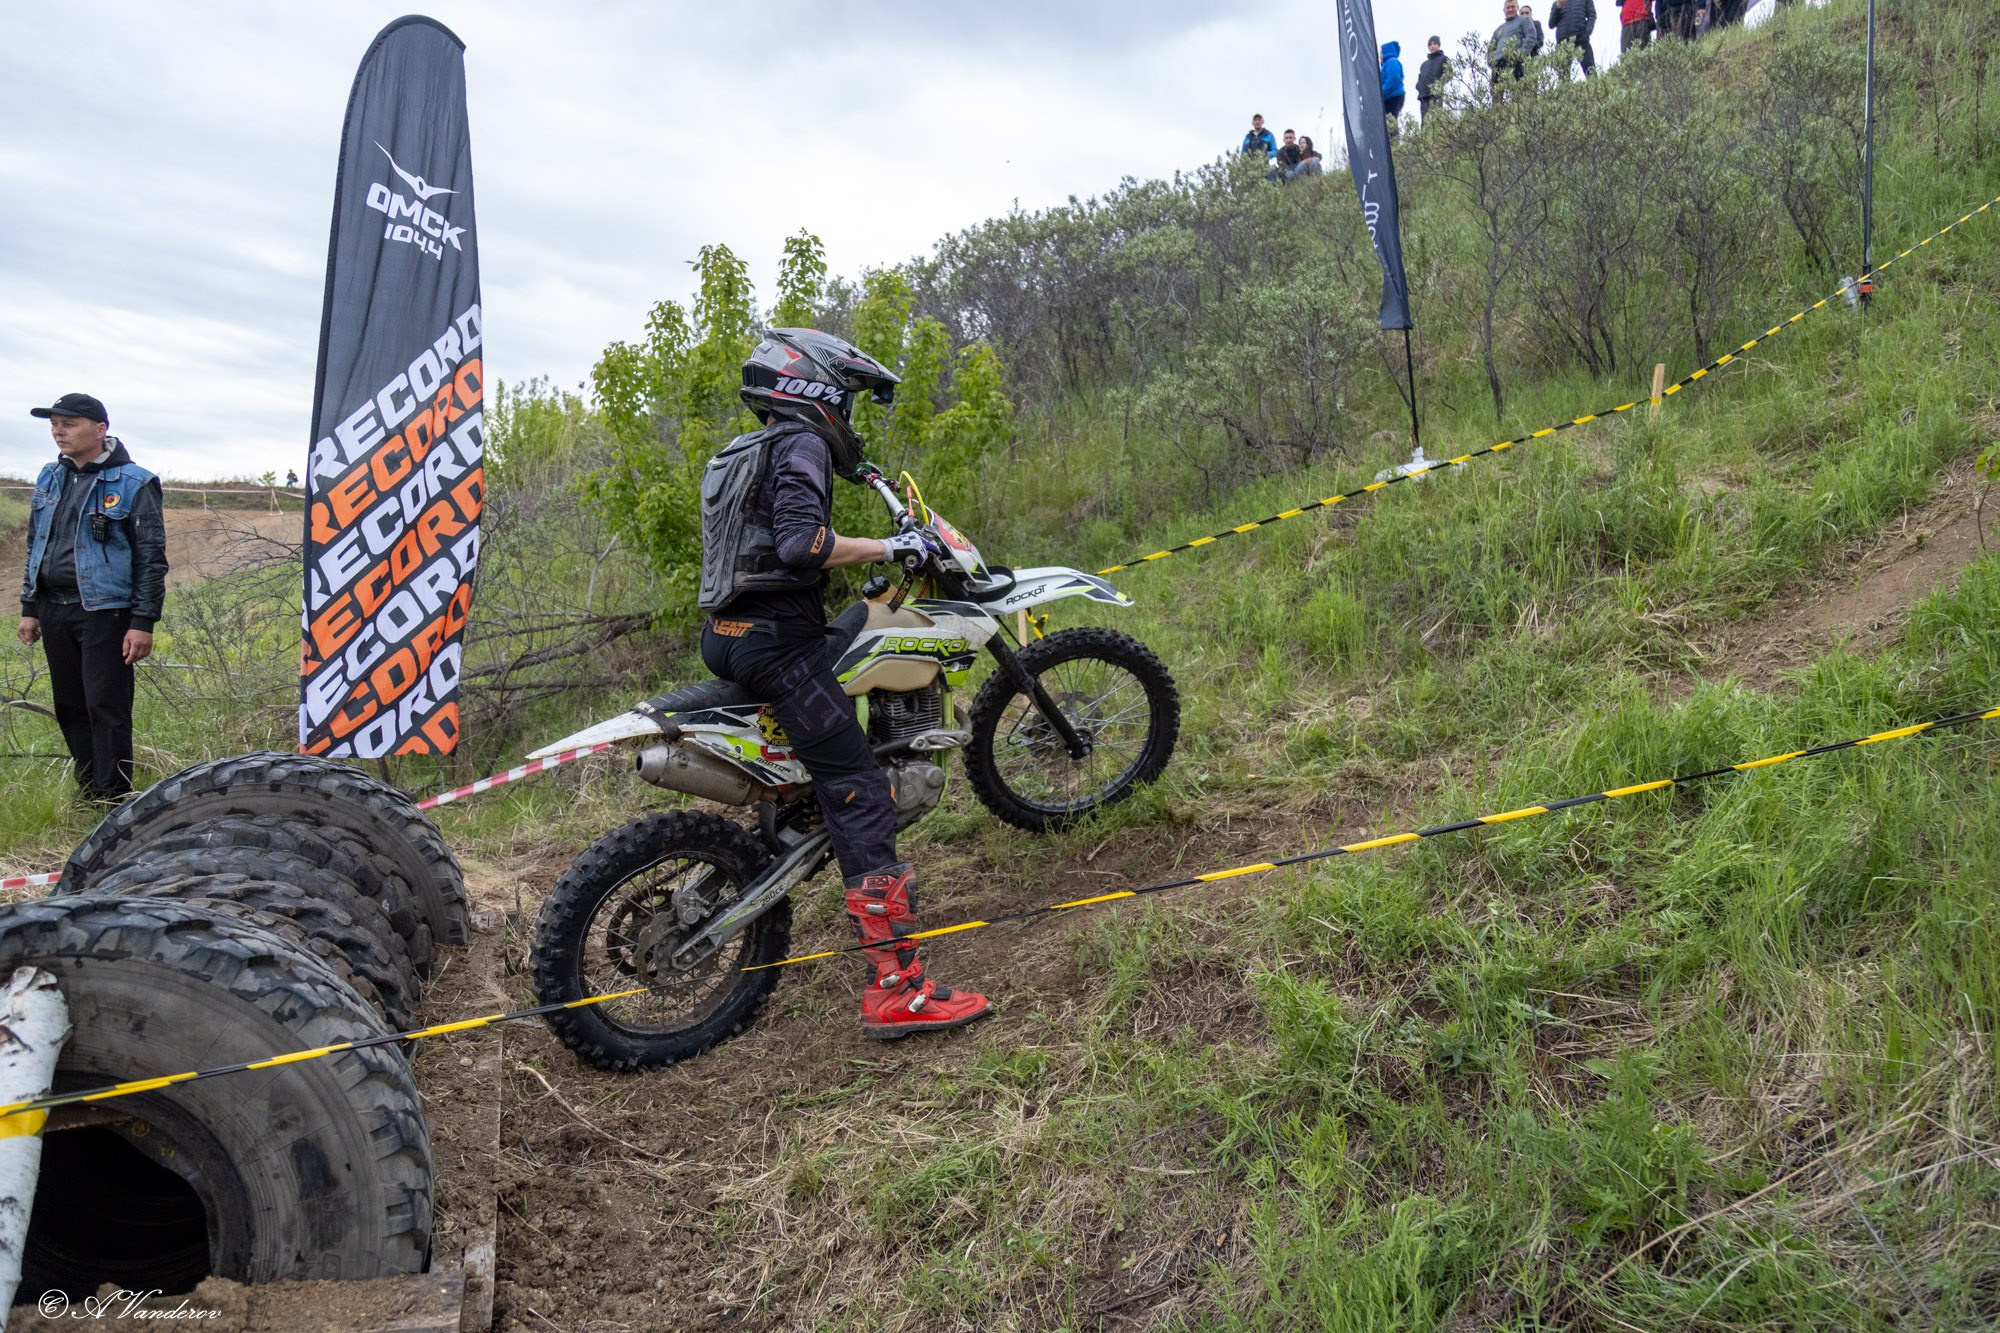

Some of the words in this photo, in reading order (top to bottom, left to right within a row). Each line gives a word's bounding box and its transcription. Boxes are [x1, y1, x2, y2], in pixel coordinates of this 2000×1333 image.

[309, 303, 482, 495] RECORD
[776, 374, 845, 405] 100%
[1006, 583, 1048, 606] ROCKOT
[713, 618, 754, 638] LEATT
